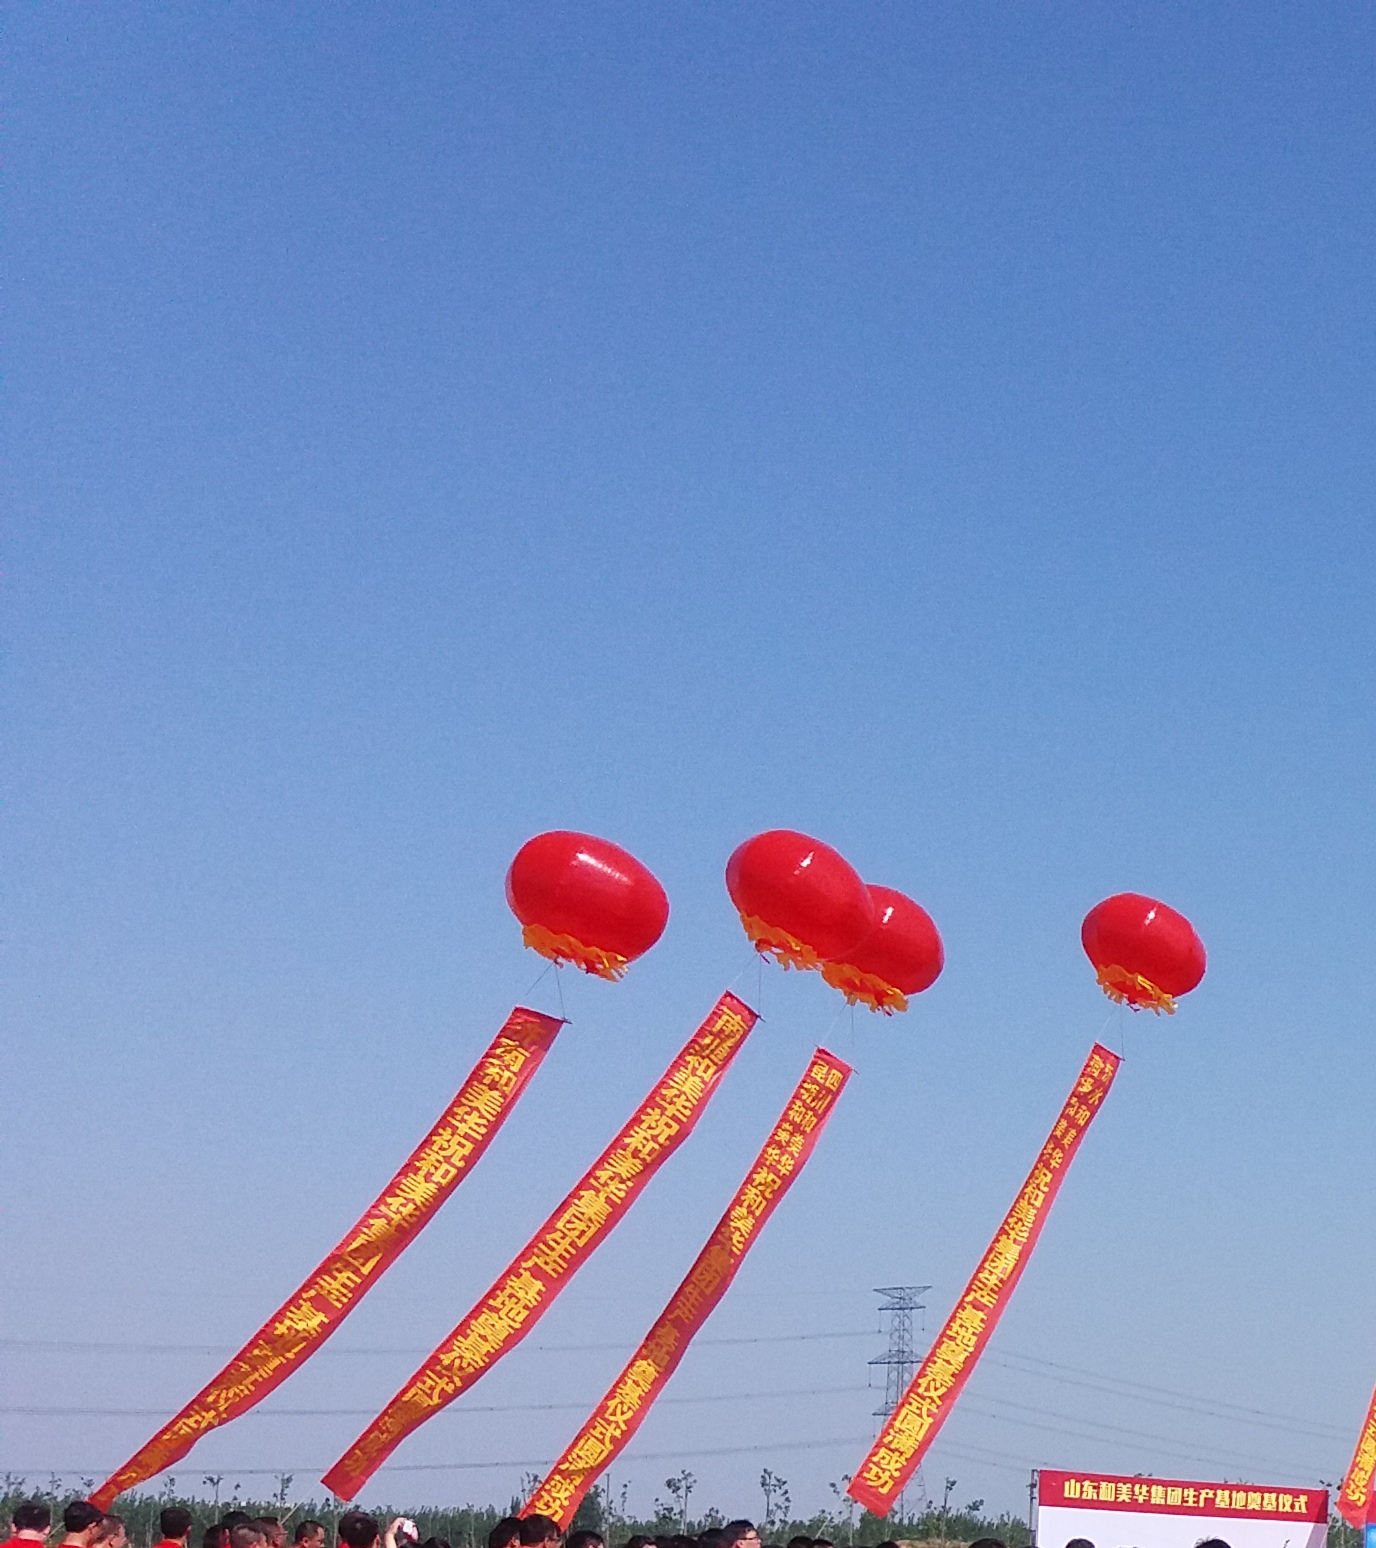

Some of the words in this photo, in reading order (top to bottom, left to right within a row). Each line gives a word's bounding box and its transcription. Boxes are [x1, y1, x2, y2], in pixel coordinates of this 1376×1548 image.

[1064, 1478, 1308, 1514] 山东和美华集团生产基地奠基仪式
